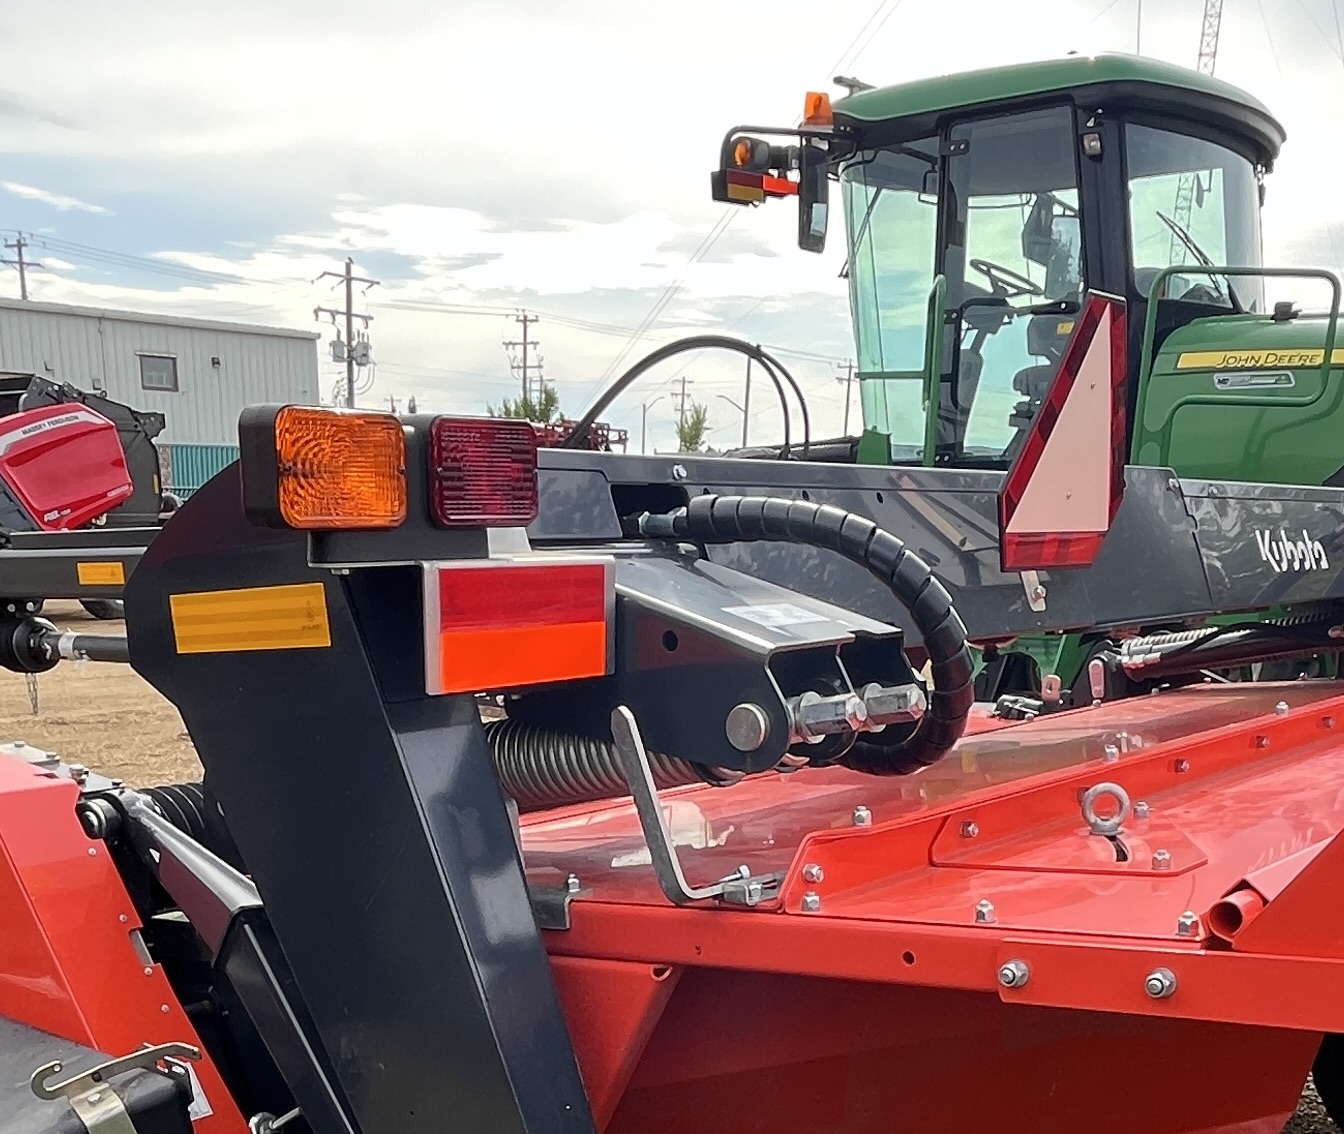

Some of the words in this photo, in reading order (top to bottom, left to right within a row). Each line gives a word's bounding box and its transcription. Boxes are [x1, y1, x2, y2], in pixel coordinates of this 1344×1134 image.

[1215, 353, 1262, 366] JOHN
[1264, 352, 1321, 365] DEERE
[1255, 529, 1330, 573] Kubota
